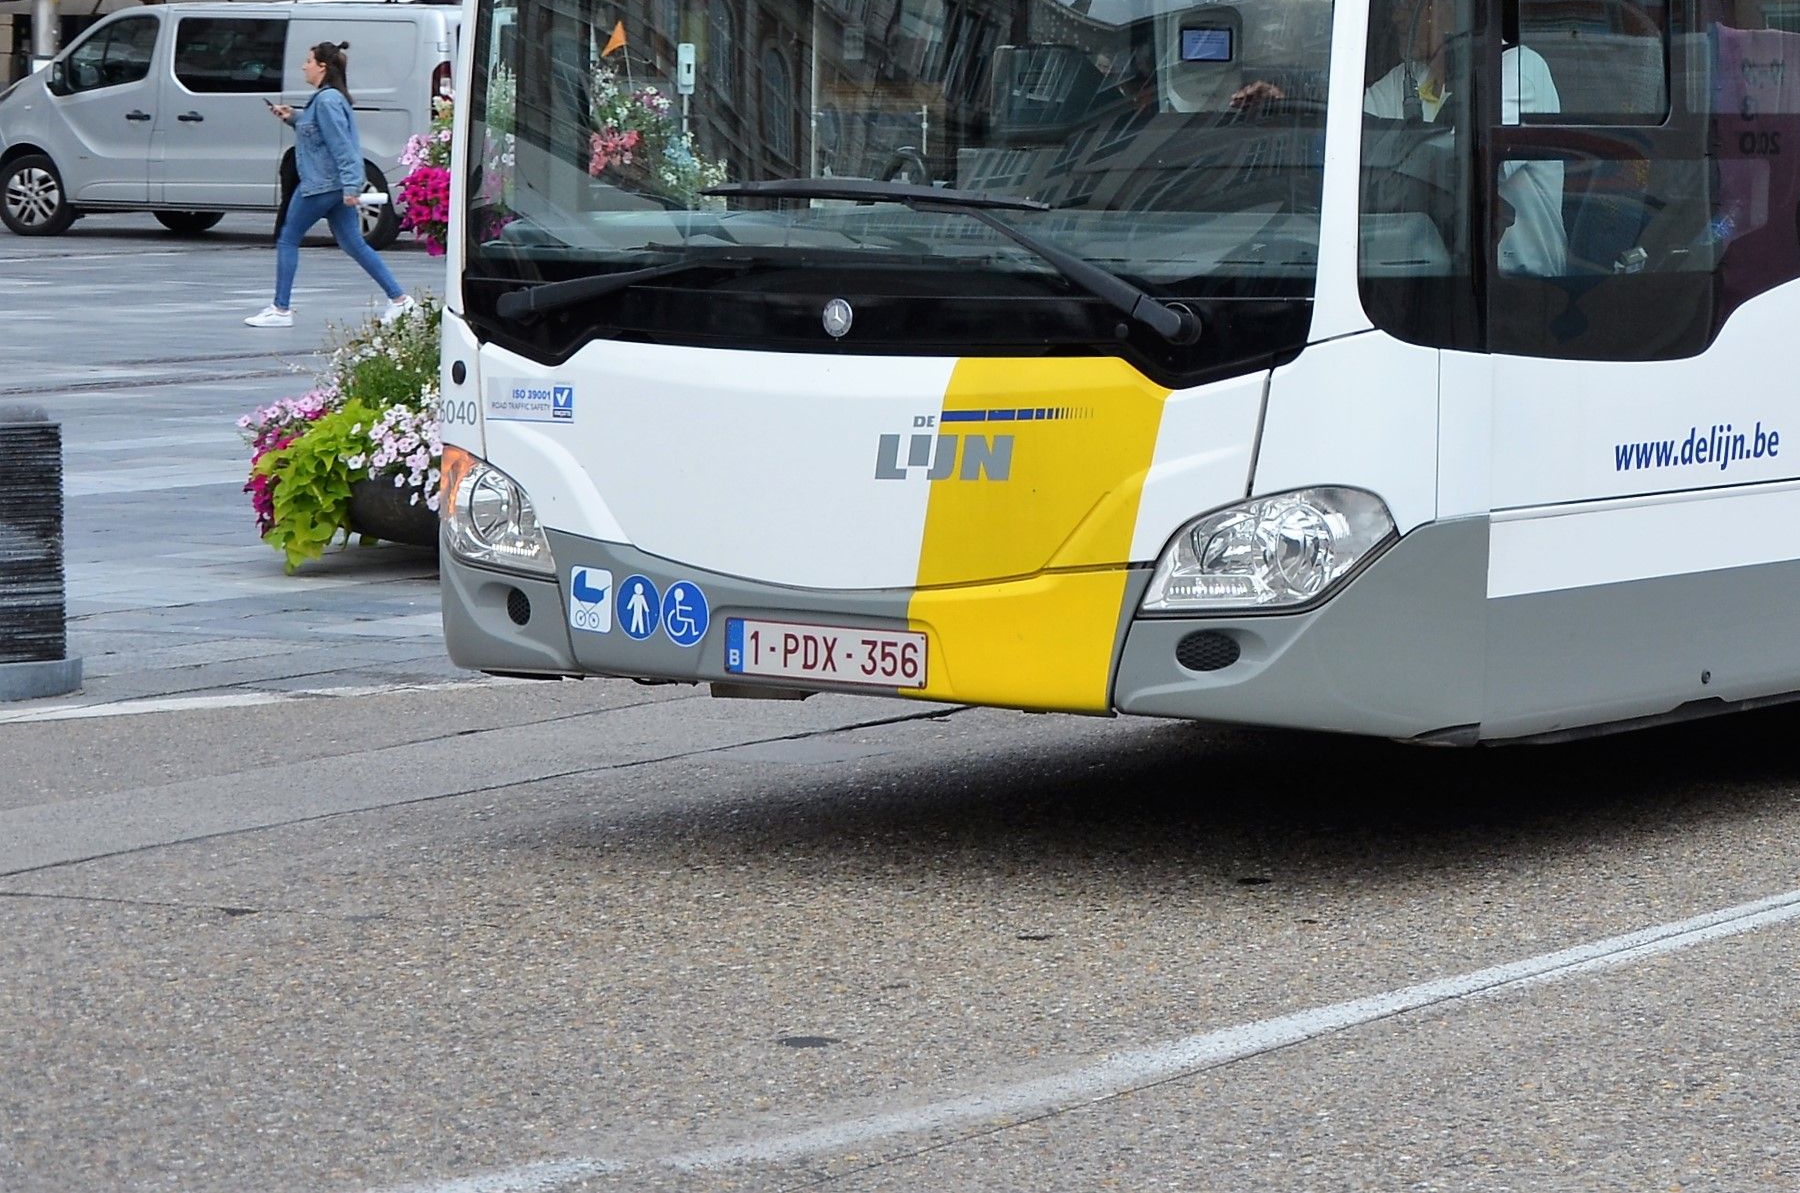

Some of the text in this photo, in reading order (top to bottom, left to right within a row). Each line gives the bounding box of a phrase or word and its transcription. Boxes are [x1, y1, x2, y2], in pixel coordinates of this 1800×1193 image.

[512, 389, 551, 401] ISO 39001
[913, 415, 936, 428] DE
[874, 433, 1015, 481] LIJN
[1614, 421, 1780, 472] www.delijn.be
[729, 630, 919, 679] B 1-PDX-356
